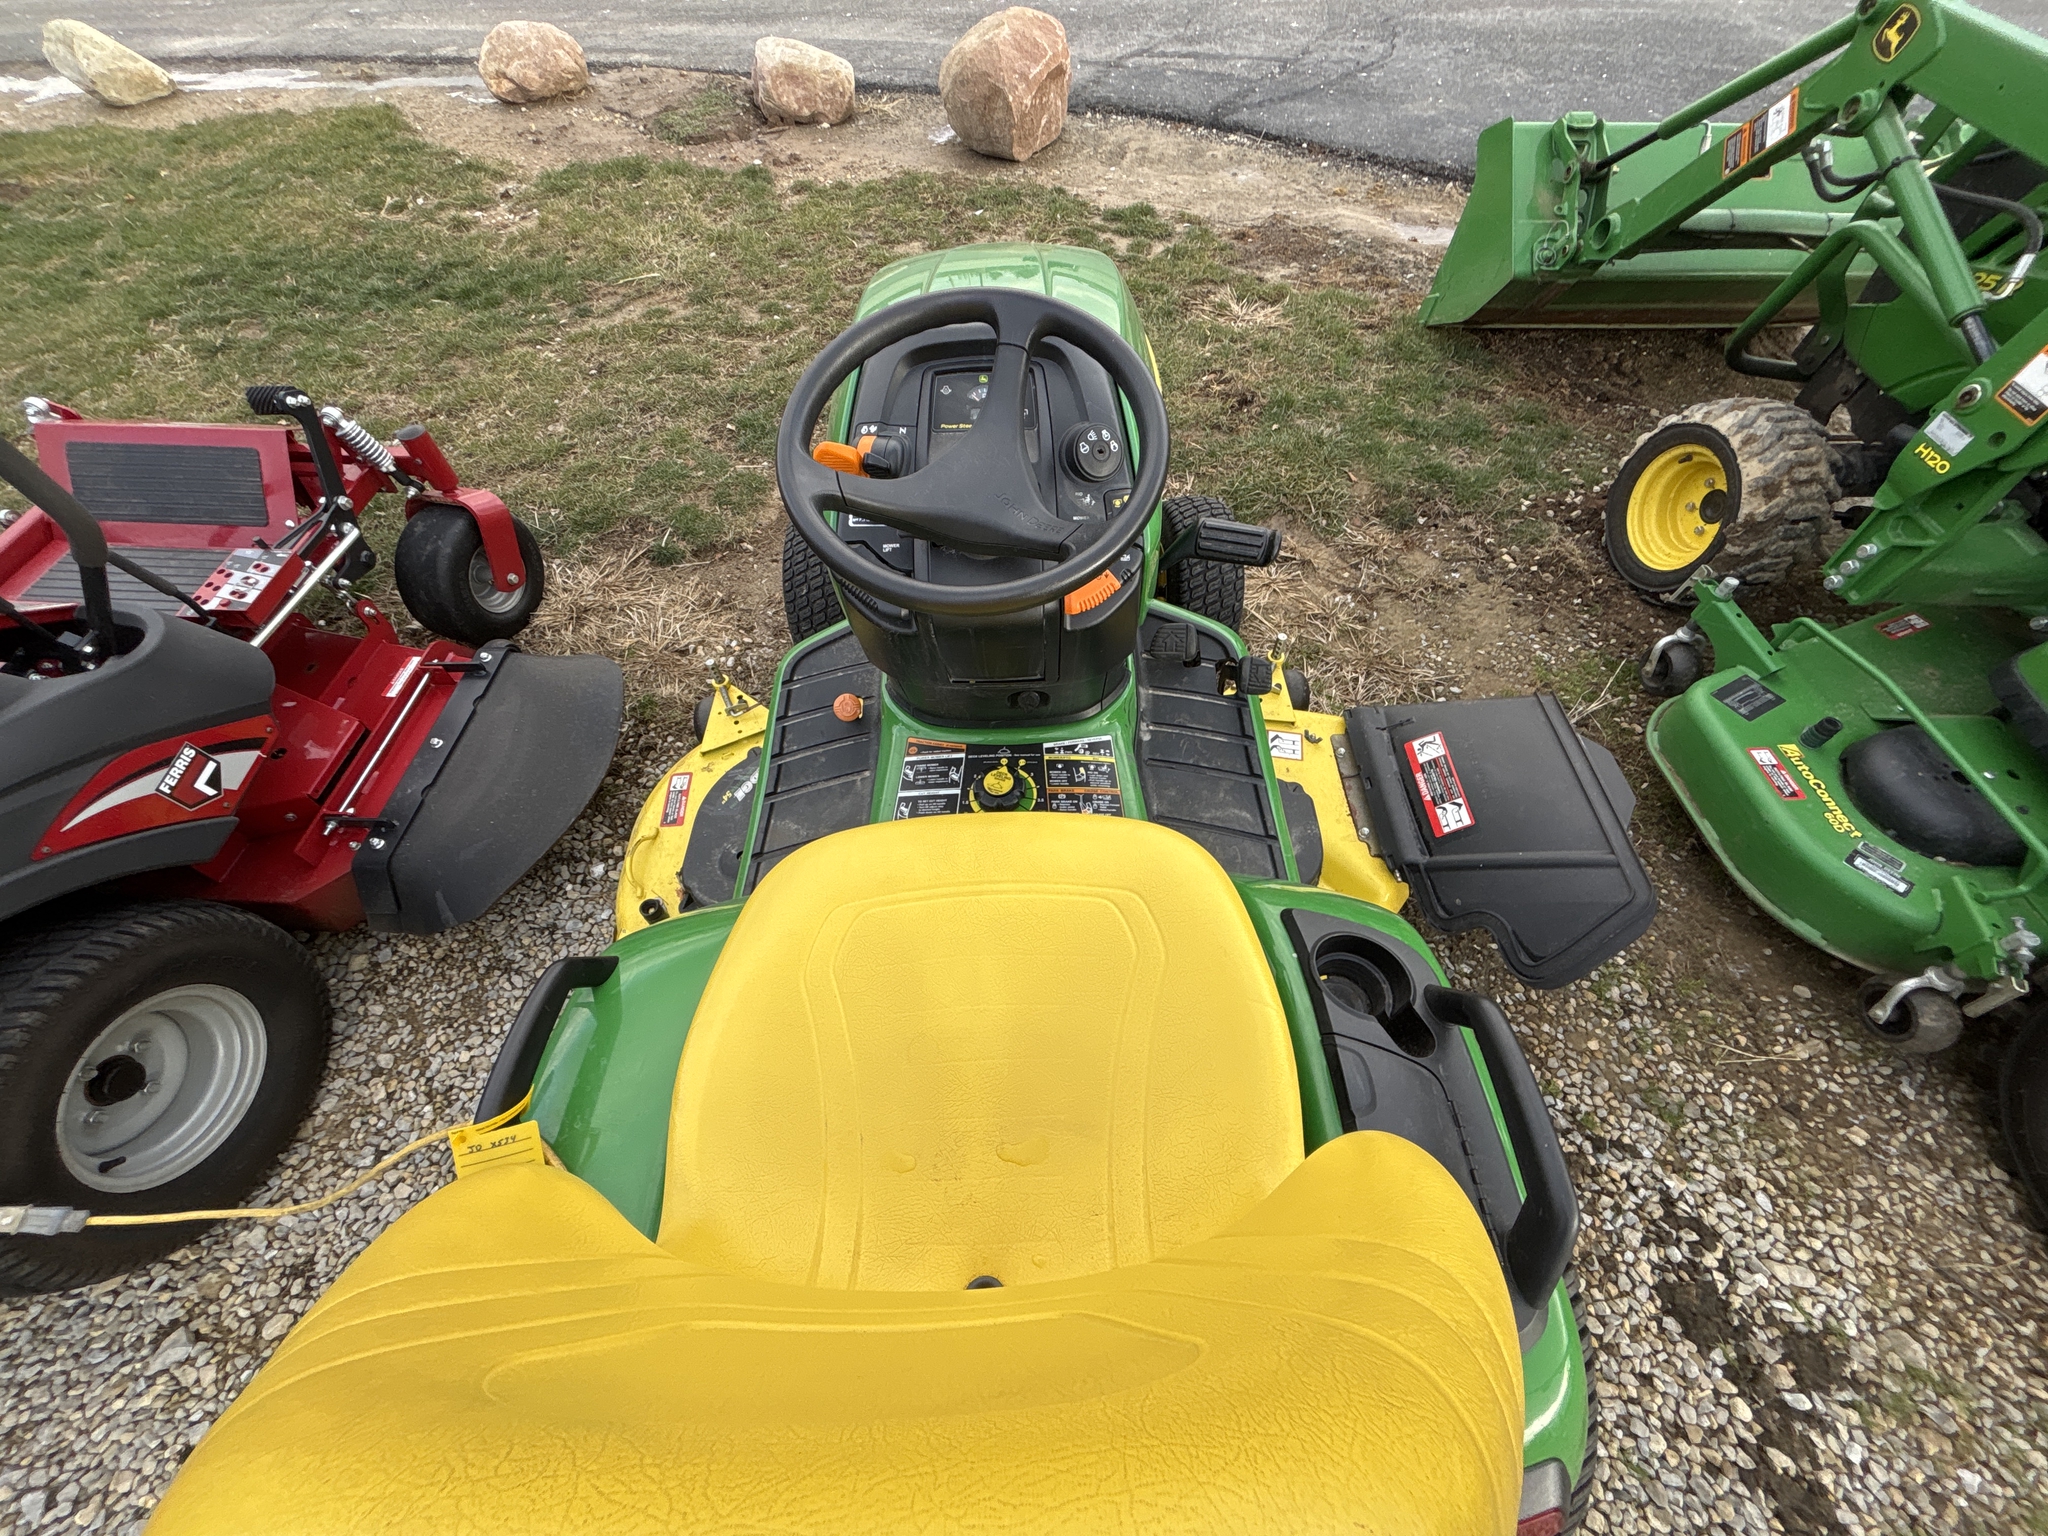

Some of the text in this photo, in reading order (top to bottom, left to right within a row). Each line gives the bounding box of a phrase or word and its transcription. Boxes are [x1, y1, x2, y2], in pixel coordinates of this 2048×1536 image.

[1914, 442, 1950, 474] H120
[996, 492, 1064, 534] JOHN DEERE
[159, 747, 196, 794] FERRIS
[1415, 772, 1429, 796] DANGER
[1778, 744, 1863, 838] AutoConnect
[1824, 812, 1846, 833] 60D
